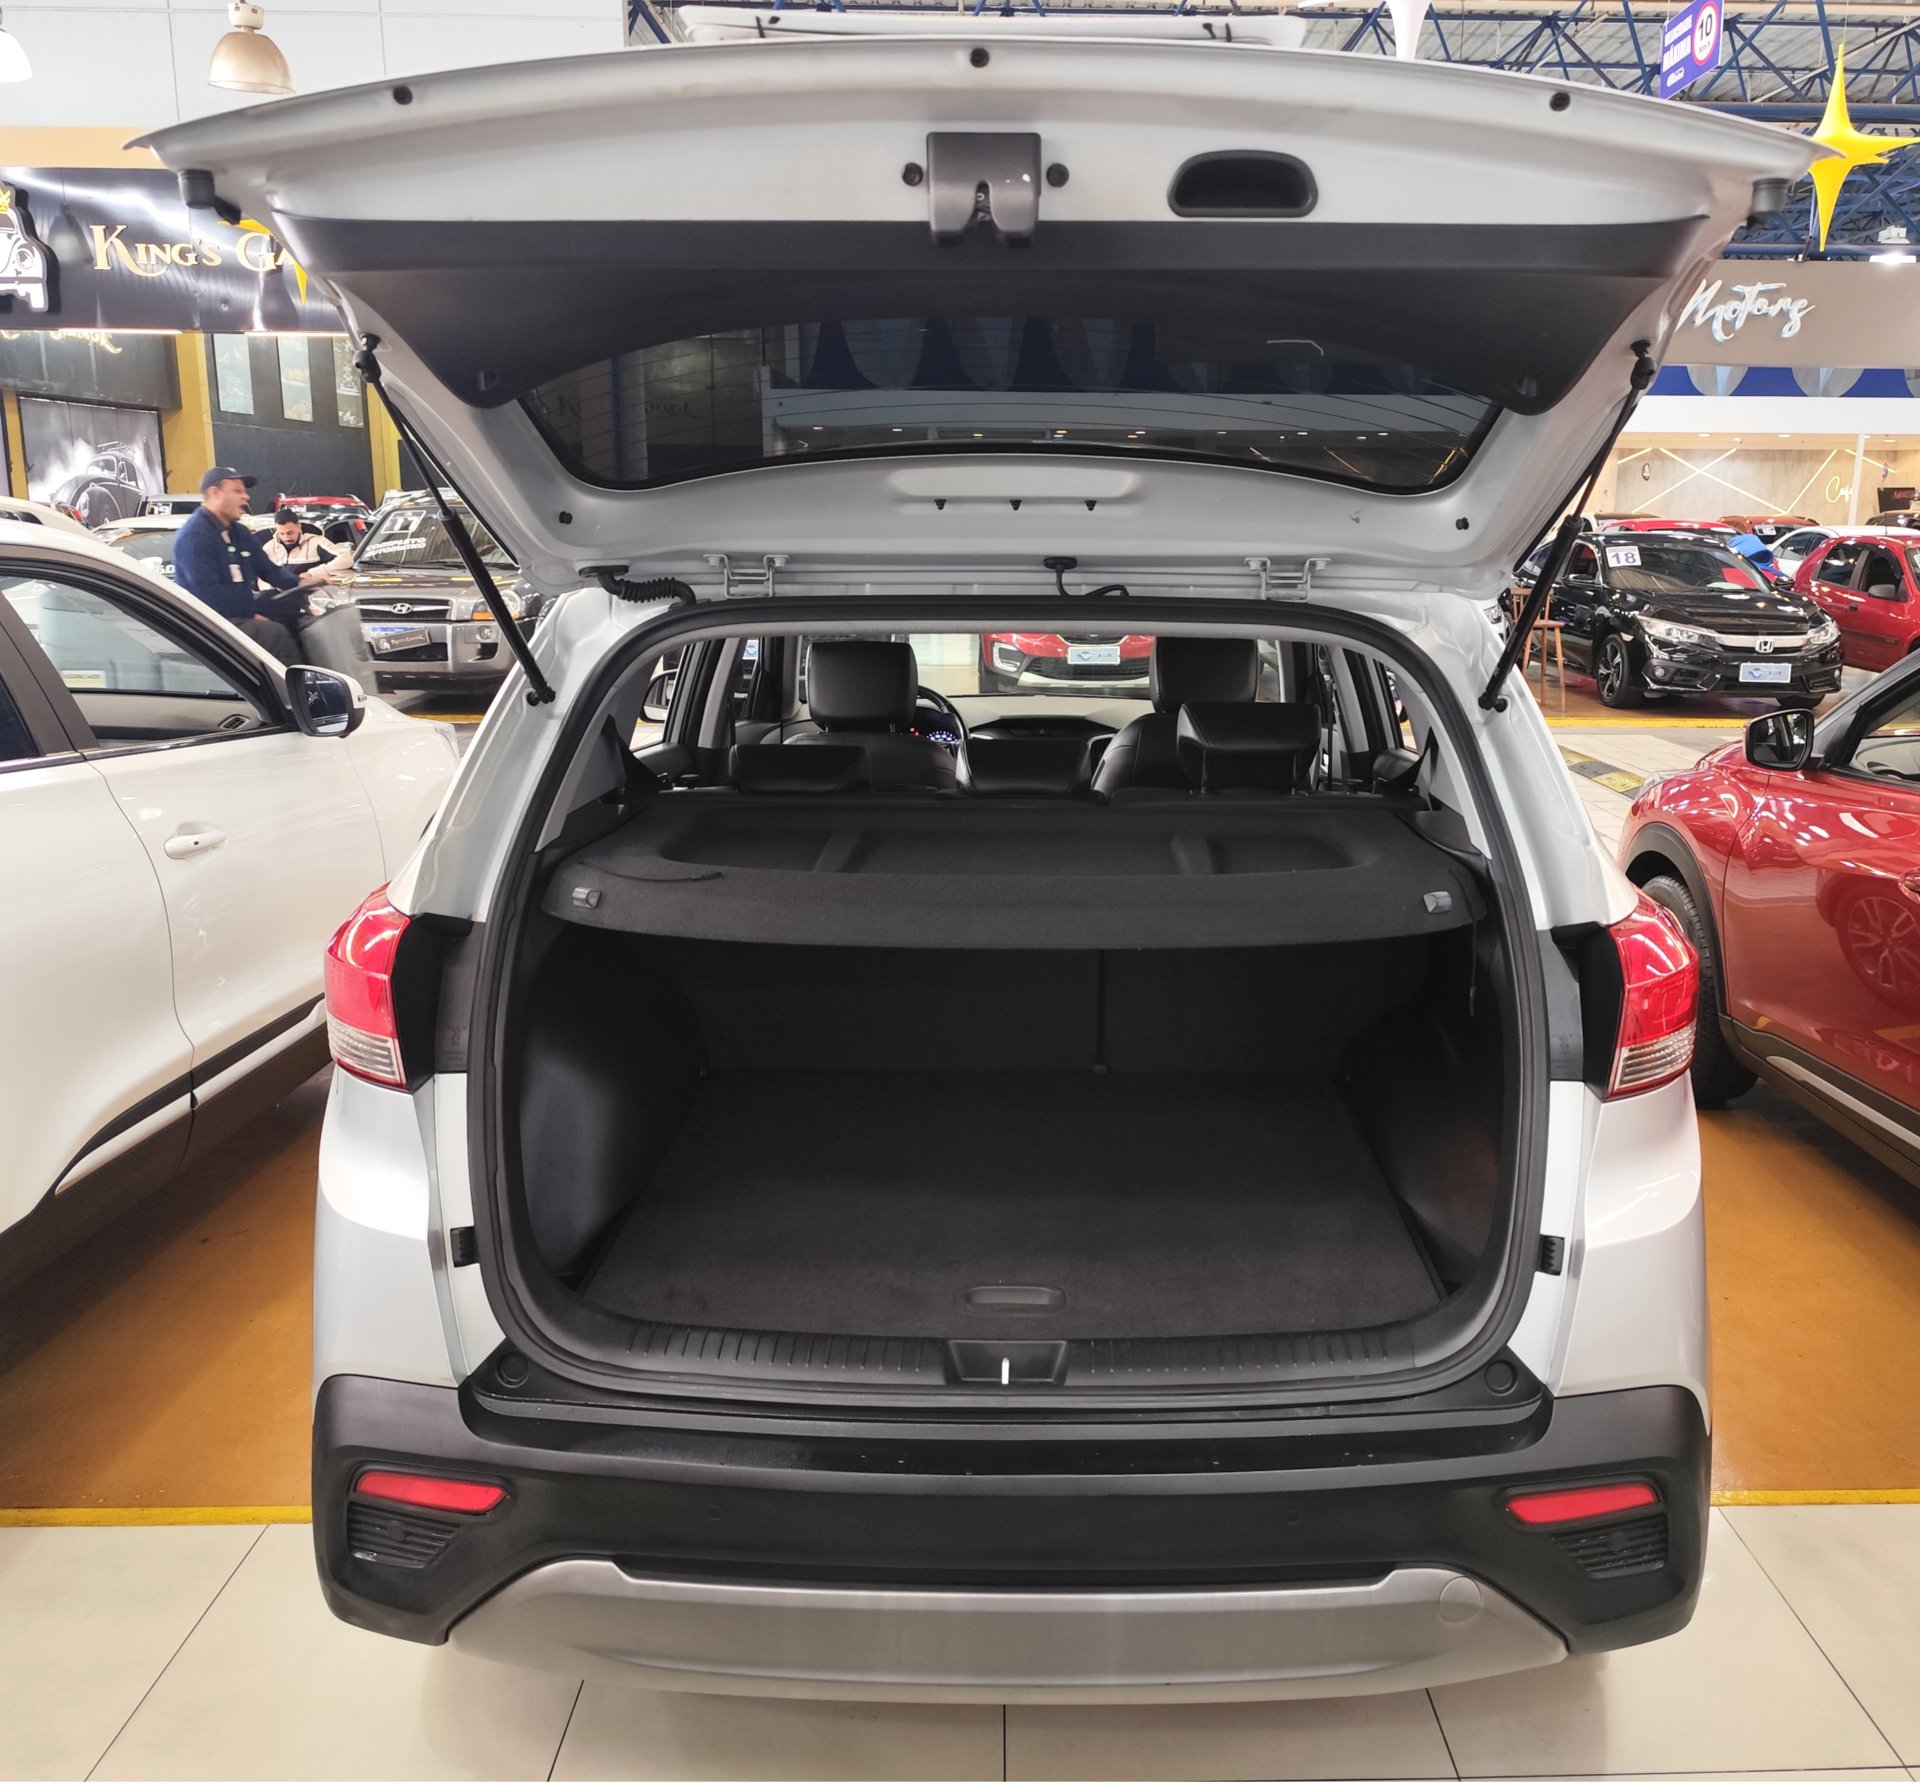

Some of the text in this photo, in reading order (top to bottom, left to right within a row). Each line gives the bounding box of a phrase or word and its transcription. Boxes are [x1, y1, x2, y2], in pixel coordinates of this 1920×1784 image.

[1698, 13, 1713, 41] 10
[235, 232, 296, 272] GA
[1611, 551, 1637, 565] 18
